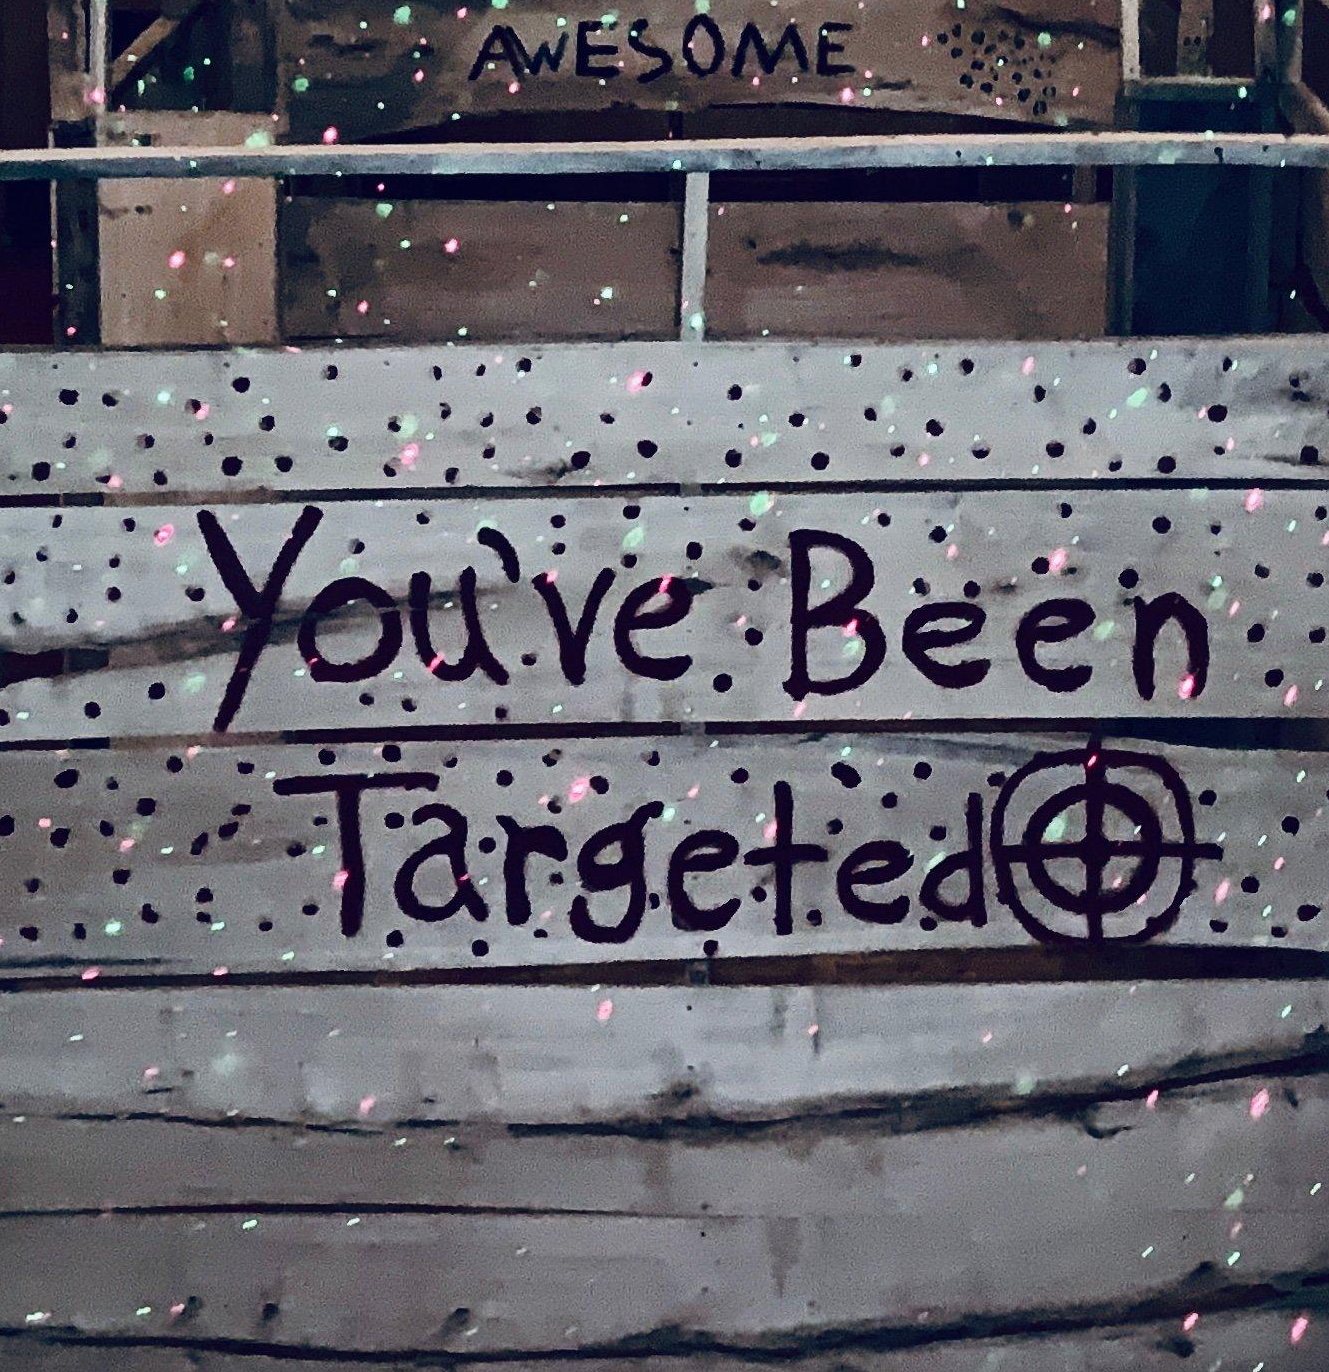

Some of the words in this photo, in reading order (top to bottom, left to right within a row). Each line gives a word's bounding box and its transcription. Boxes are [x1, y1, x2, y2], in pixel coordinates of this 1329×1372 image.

[468, 12, 855, 83] AWESOME
[197, 505, 695, 733] You've
[782, 527, 1210, 702] Been
[272, 771, 988, 945] Targeted
